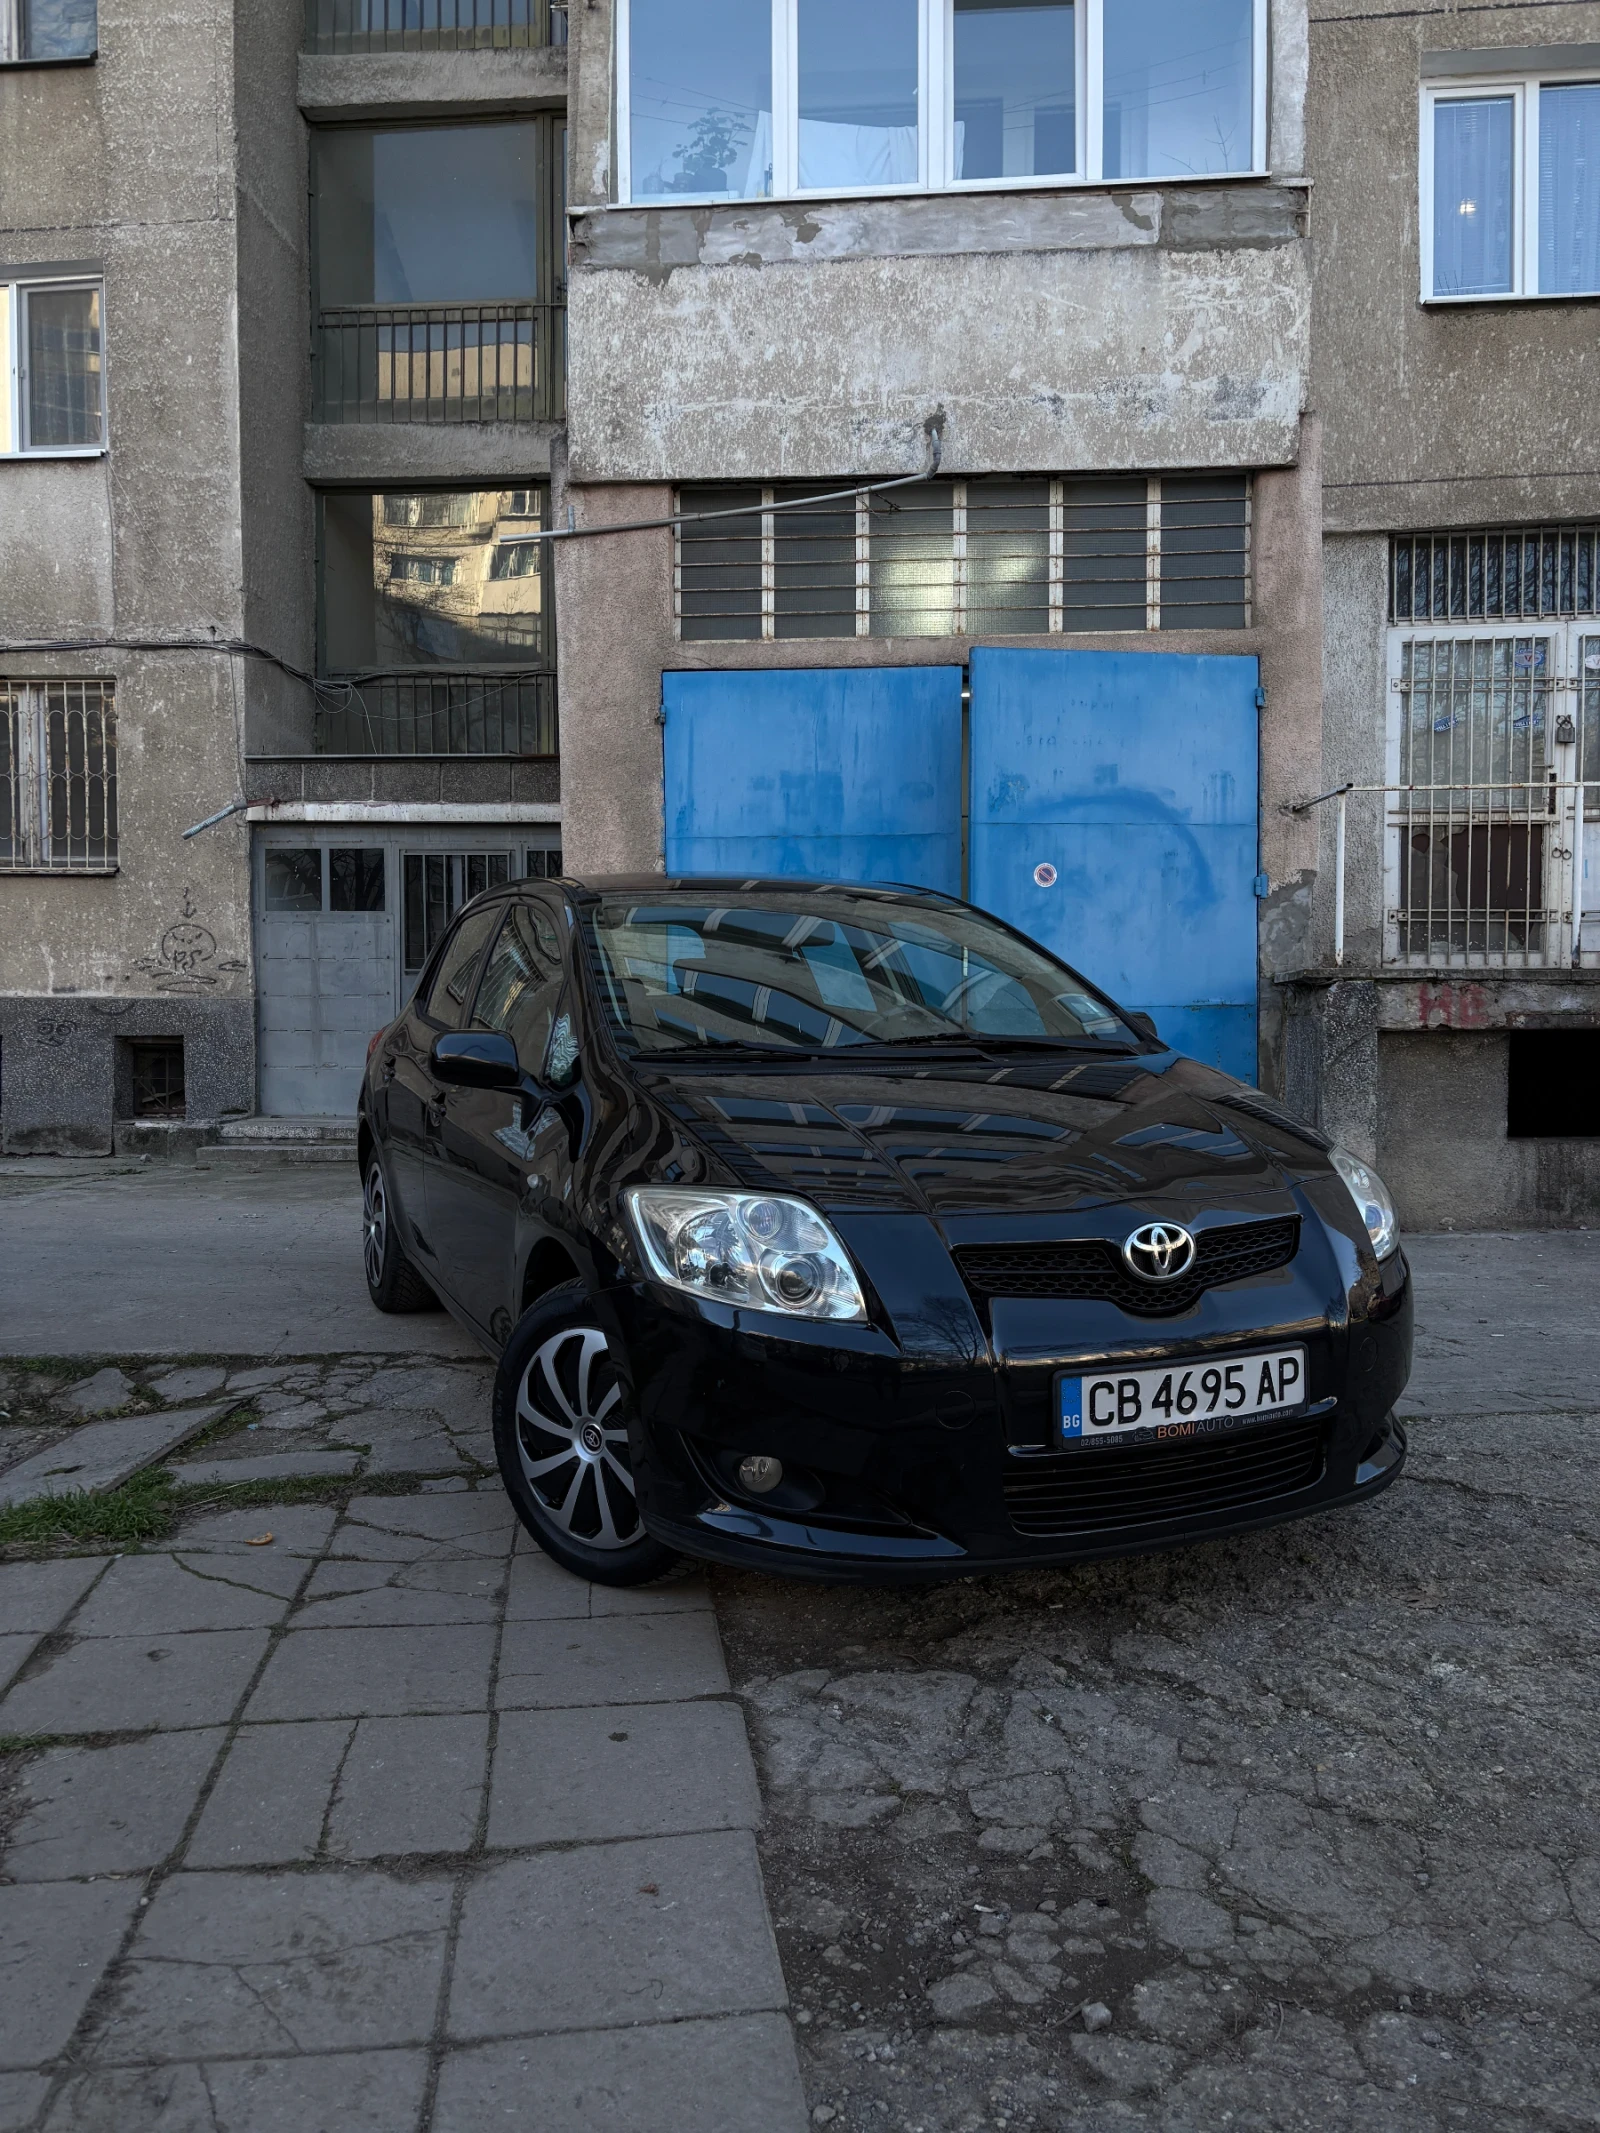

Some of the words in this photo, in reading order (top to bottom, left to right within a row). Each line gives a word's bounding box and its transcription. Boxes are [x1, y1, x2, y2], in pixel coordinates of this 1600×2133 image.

[1089, 1378, 1142, 1427] CB
[1151, 1363, 1247, 1419] 4695
[1256, 1356, 1300, 1406] AP
[1063, 1413, 1081, 1429] BG
